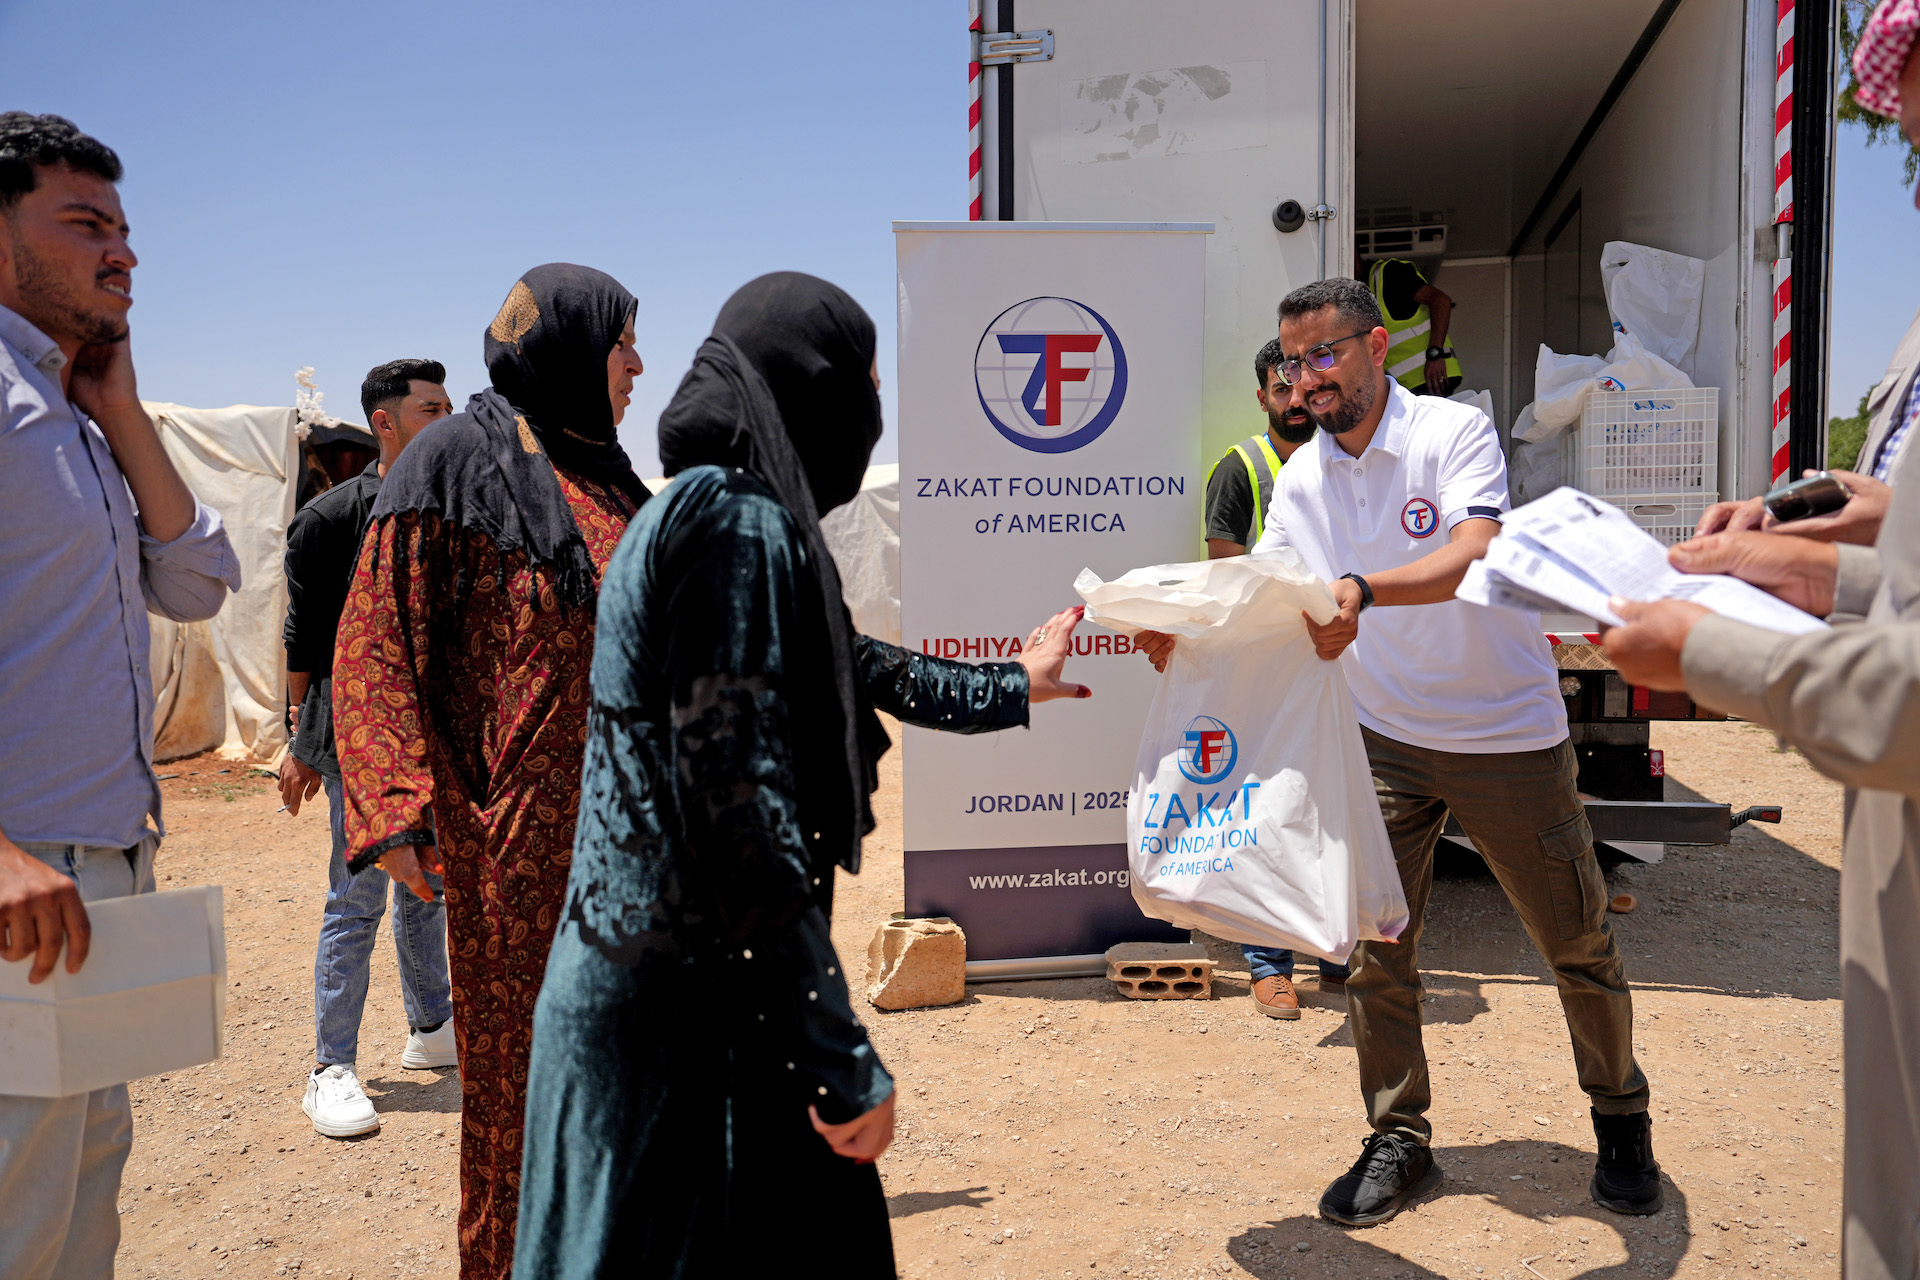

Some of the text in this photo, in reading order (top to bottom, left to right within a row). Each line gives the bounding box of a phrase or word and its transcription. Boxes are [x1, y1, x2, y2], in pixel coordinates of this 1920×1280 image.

[917, 476, 1185, 497] ZAKAT FOUNDATION
[975, 513, 1126, 534] of AMERICA
[923, 636, 1029, 659] UDHIYA
[965, 793, 1064, 814] JORDAN
[1144, 782, 1260, 829] ZAKAT
[1140, 827, 1257, 854] FOUNDAION
[1160, 857, 1234, 876] of AMERICA
[969, 868, 1130, 890] www.zakat.org
